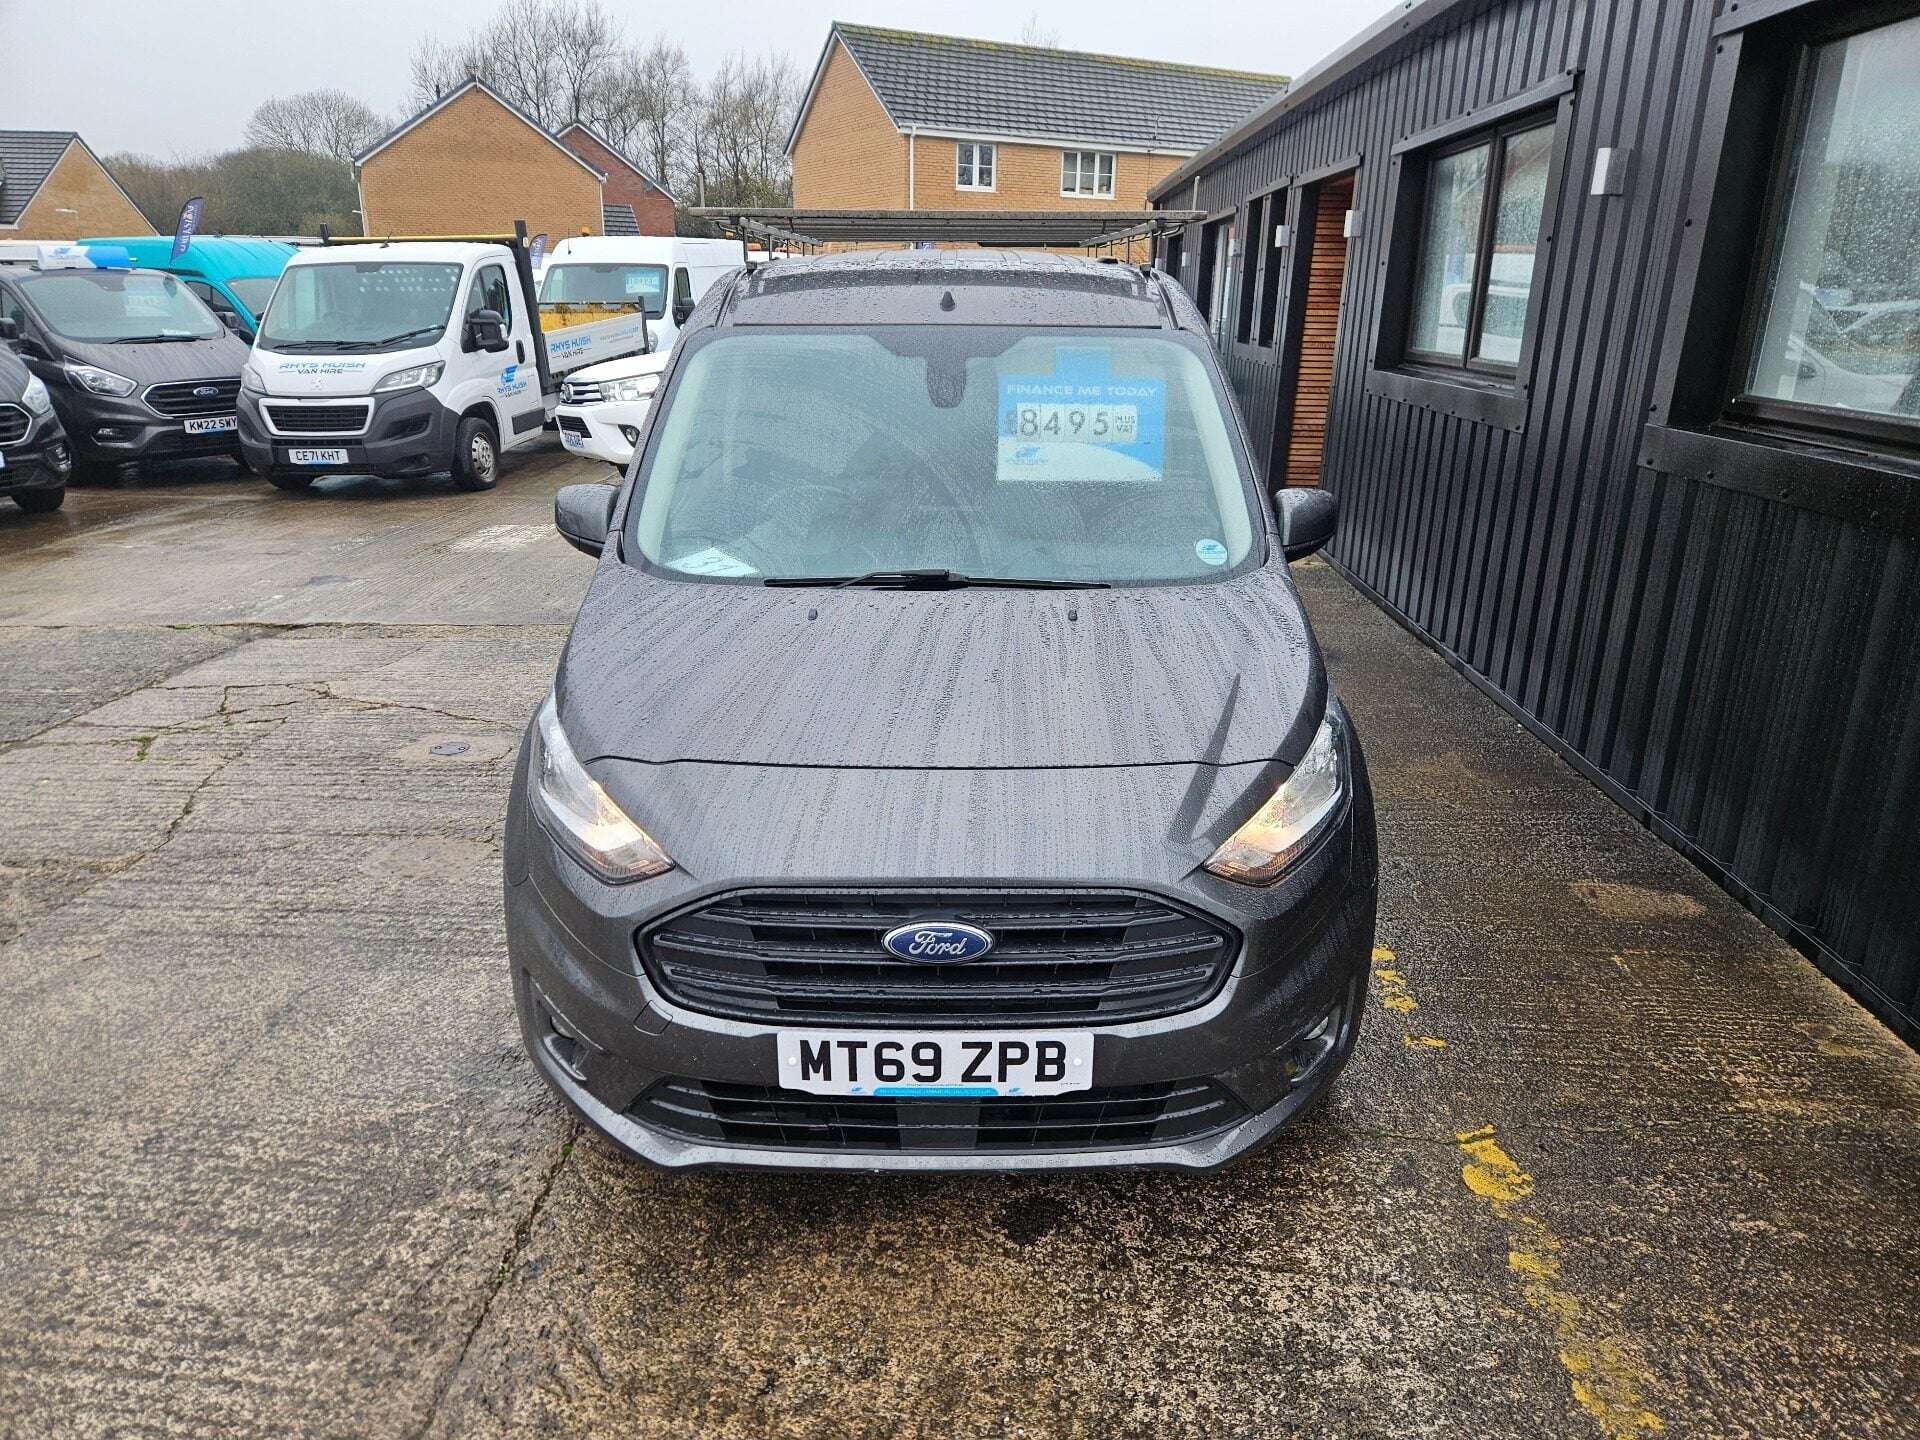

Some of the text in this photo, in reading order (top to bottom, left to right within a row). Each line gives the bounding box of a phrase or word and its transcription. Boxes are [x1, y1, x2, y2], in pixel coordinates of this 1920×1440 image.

[550, 336, 592, 352] RHYS HUISH
[1007, 384, 1157, 397] FINANCE ME TODAY
[189, 420, 217, 430] KM22
[1117, 425, 1133, 433] VAT
[296, 451, 340, 461] CE71 KHT
[908, 930, 968, 956] Ford
[800, 1040, 1066, 1082] MT69 ZPB
